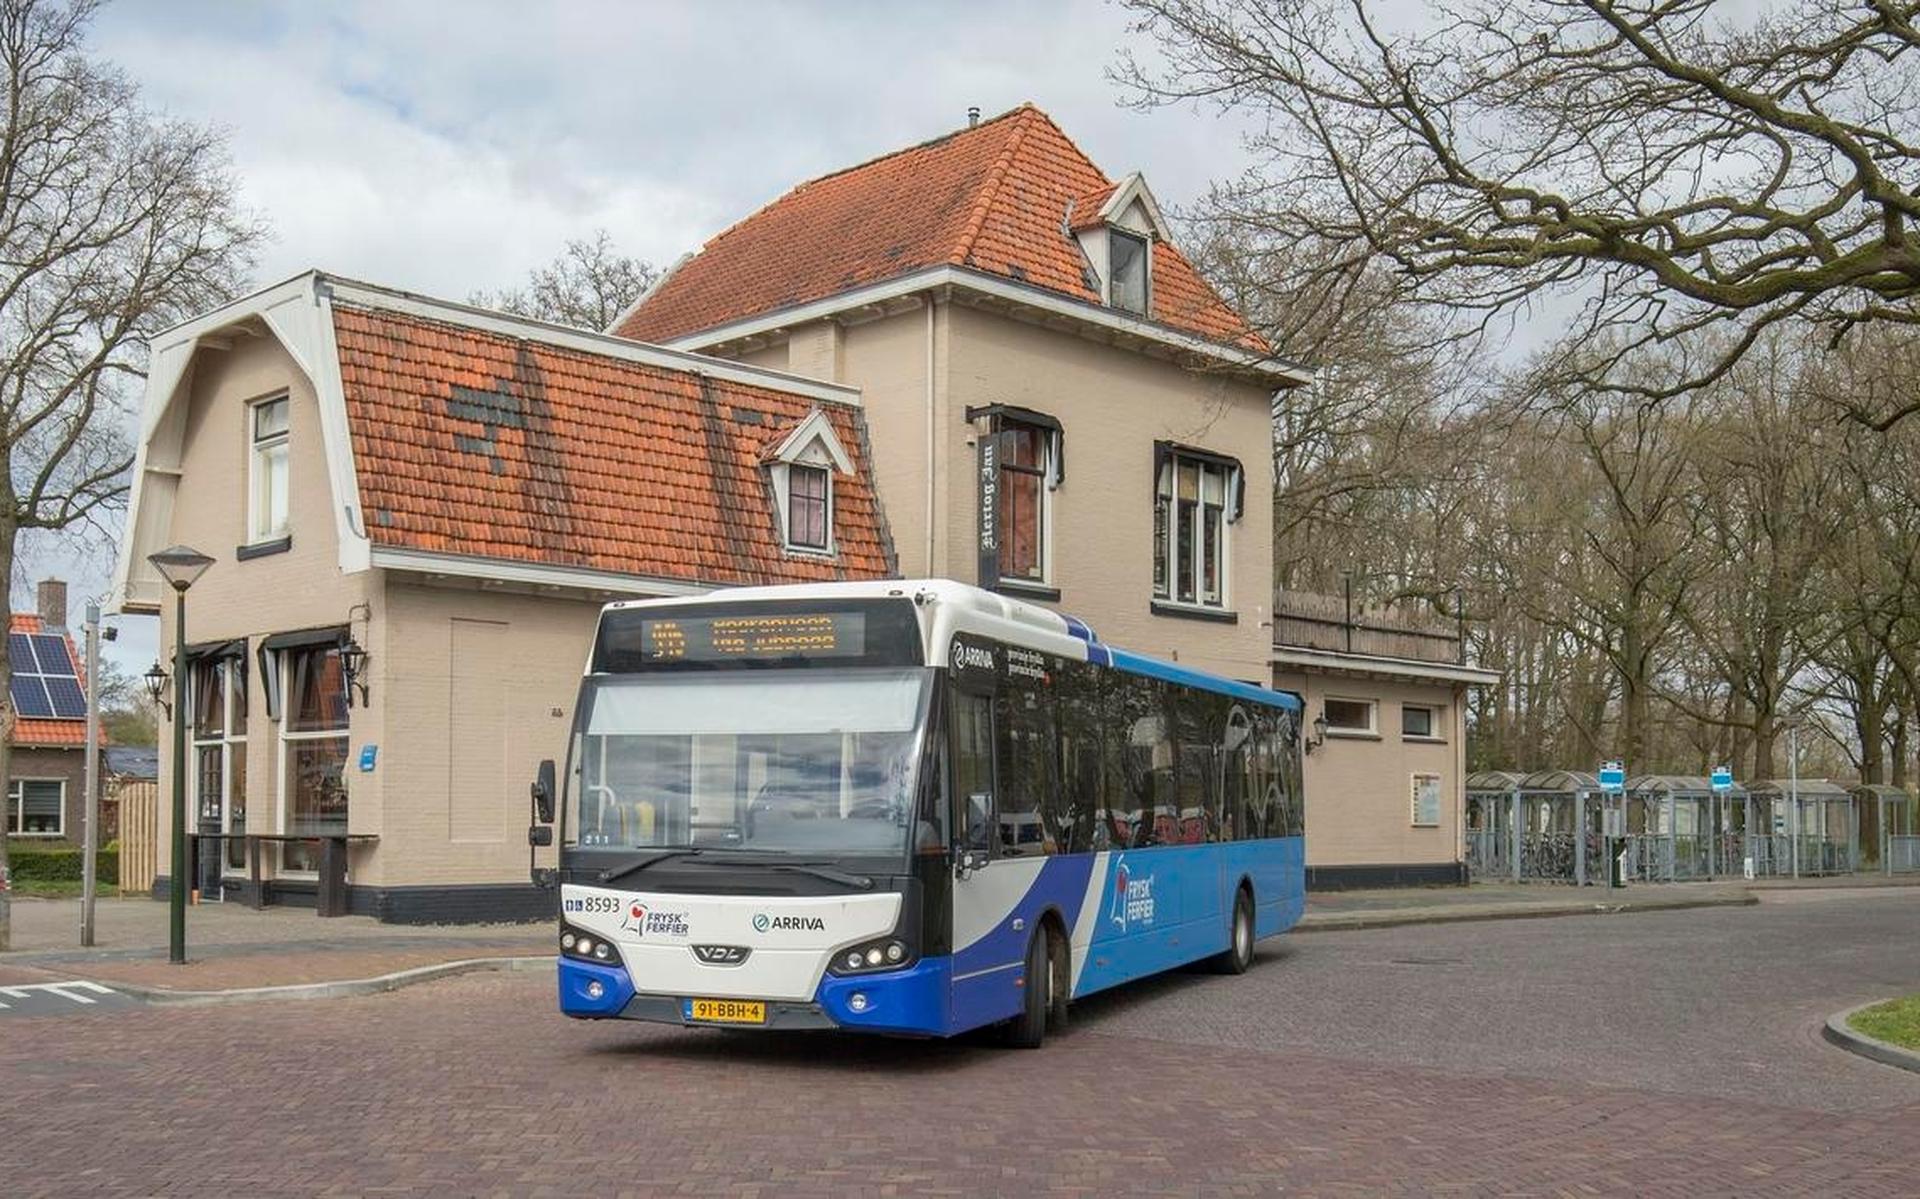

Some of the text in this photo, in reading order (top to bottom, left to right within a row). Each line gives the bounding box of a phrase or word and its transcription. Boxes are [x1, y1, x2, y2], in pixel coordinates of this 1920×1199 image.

[964, 646, 994, 669] ARRIVA
[585, 897, 620, 913] 8593
[648, 912, 682, 923] FRYSK
[772, 916, 825, 931] ARRIVA
[646, 922, 689, 934] FERFIER
[698, 946, 740, 960] VDL
[699, 1003, 759, 1018] 91-BBH-4
